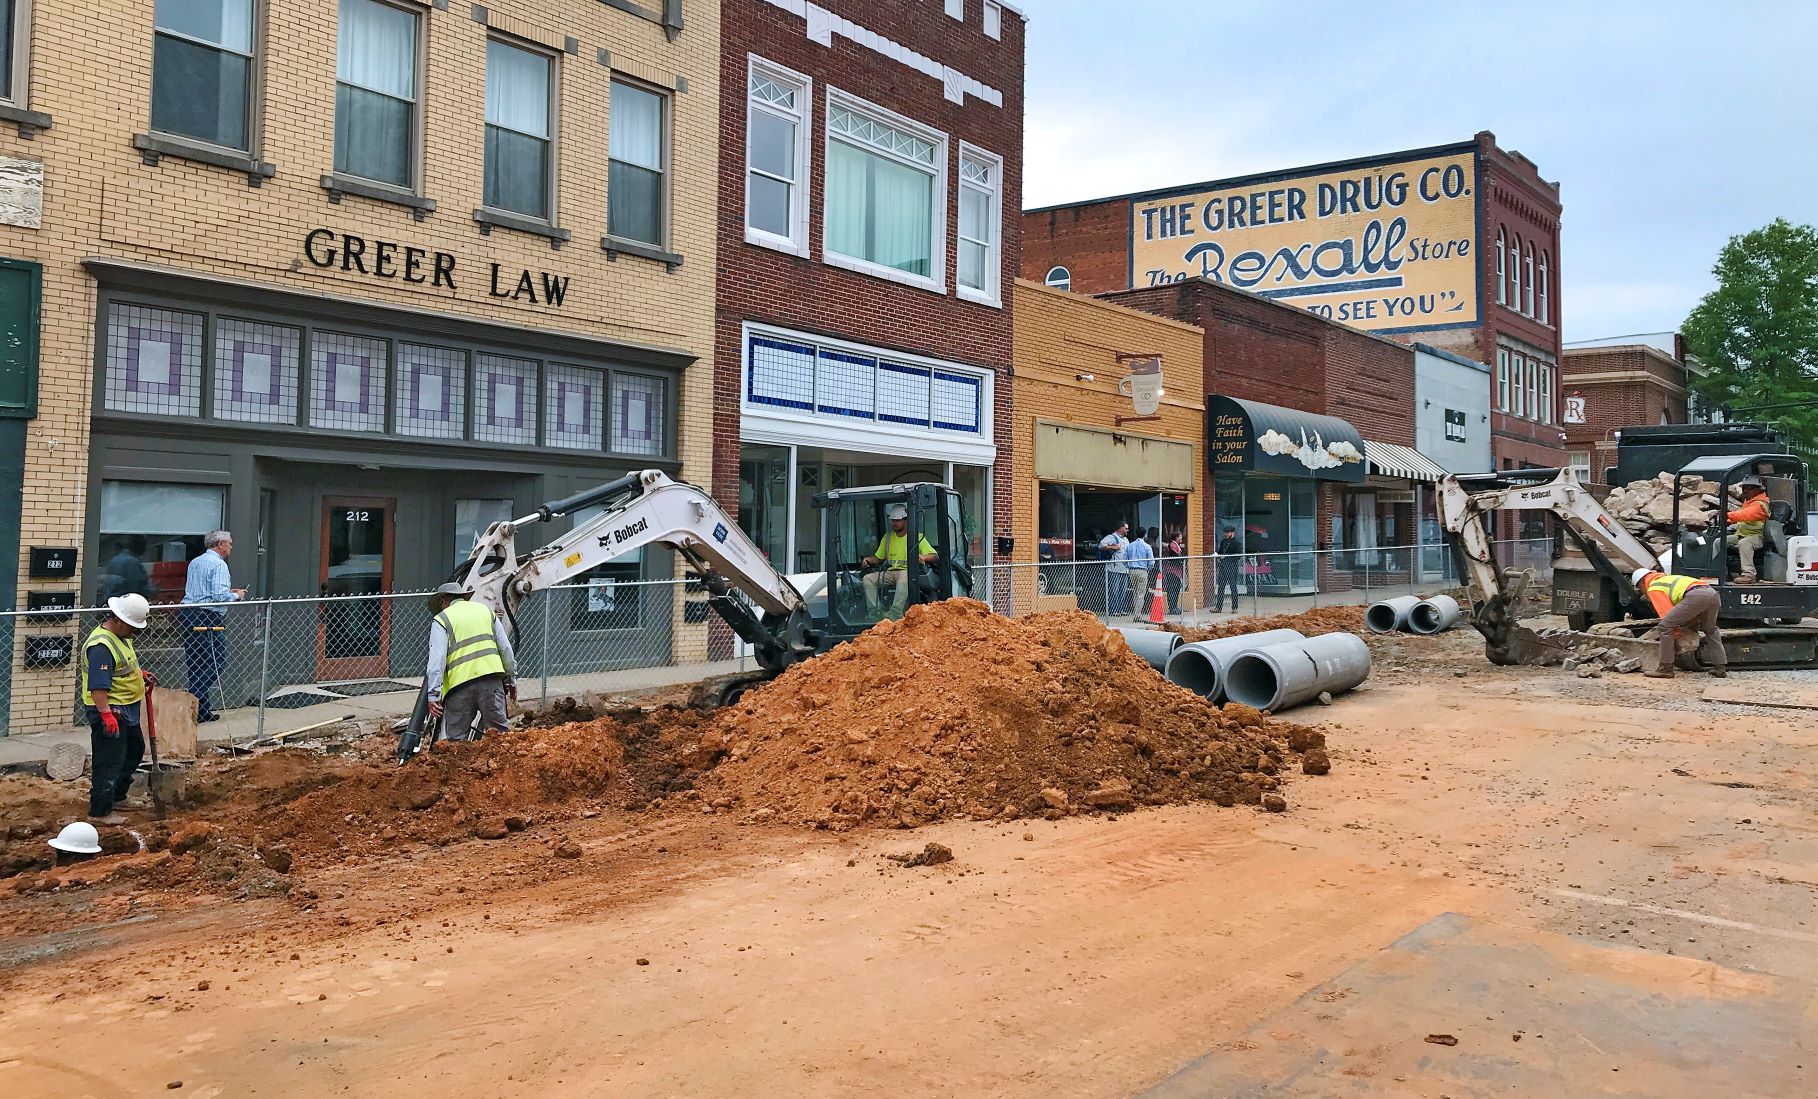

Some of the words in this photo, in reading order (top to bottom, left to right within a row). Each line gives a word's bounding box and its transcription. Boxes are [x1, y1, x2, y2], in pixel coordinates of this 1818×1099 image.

[1142, 203, 1194, 241] THE
[1203, 187, 1307, 232] GREER
[1318, 172, 1410, 217] DRUG
[1419, 164, 1471, 202] CO.
[1146, 268, 1187, 286] The
[1184, 216, 1407, 288] Rexall
[1407, 237, 1470, 262] Store
[304, 229, 458, 289] GREER
[488, 262, 571, 307] LAW
[1338, 300, 1378, 321] SEE
[1216, 415, 1243, 426] Have
[1215, 426, 1244, 438] Faith
[1212, 440, 1222, 449] in
[1223, 441, 1247, 452] your
[1215, 453, 1243, 464] Salon
[1531, 490, 1552, 499] Bobcat
[346, 511, 369, 521] 212
[614, 516, 649, 544] Bobcat
[1556, 590, 1587, 599] DOUBLE
[1740, 593, 1762, 605] E42
